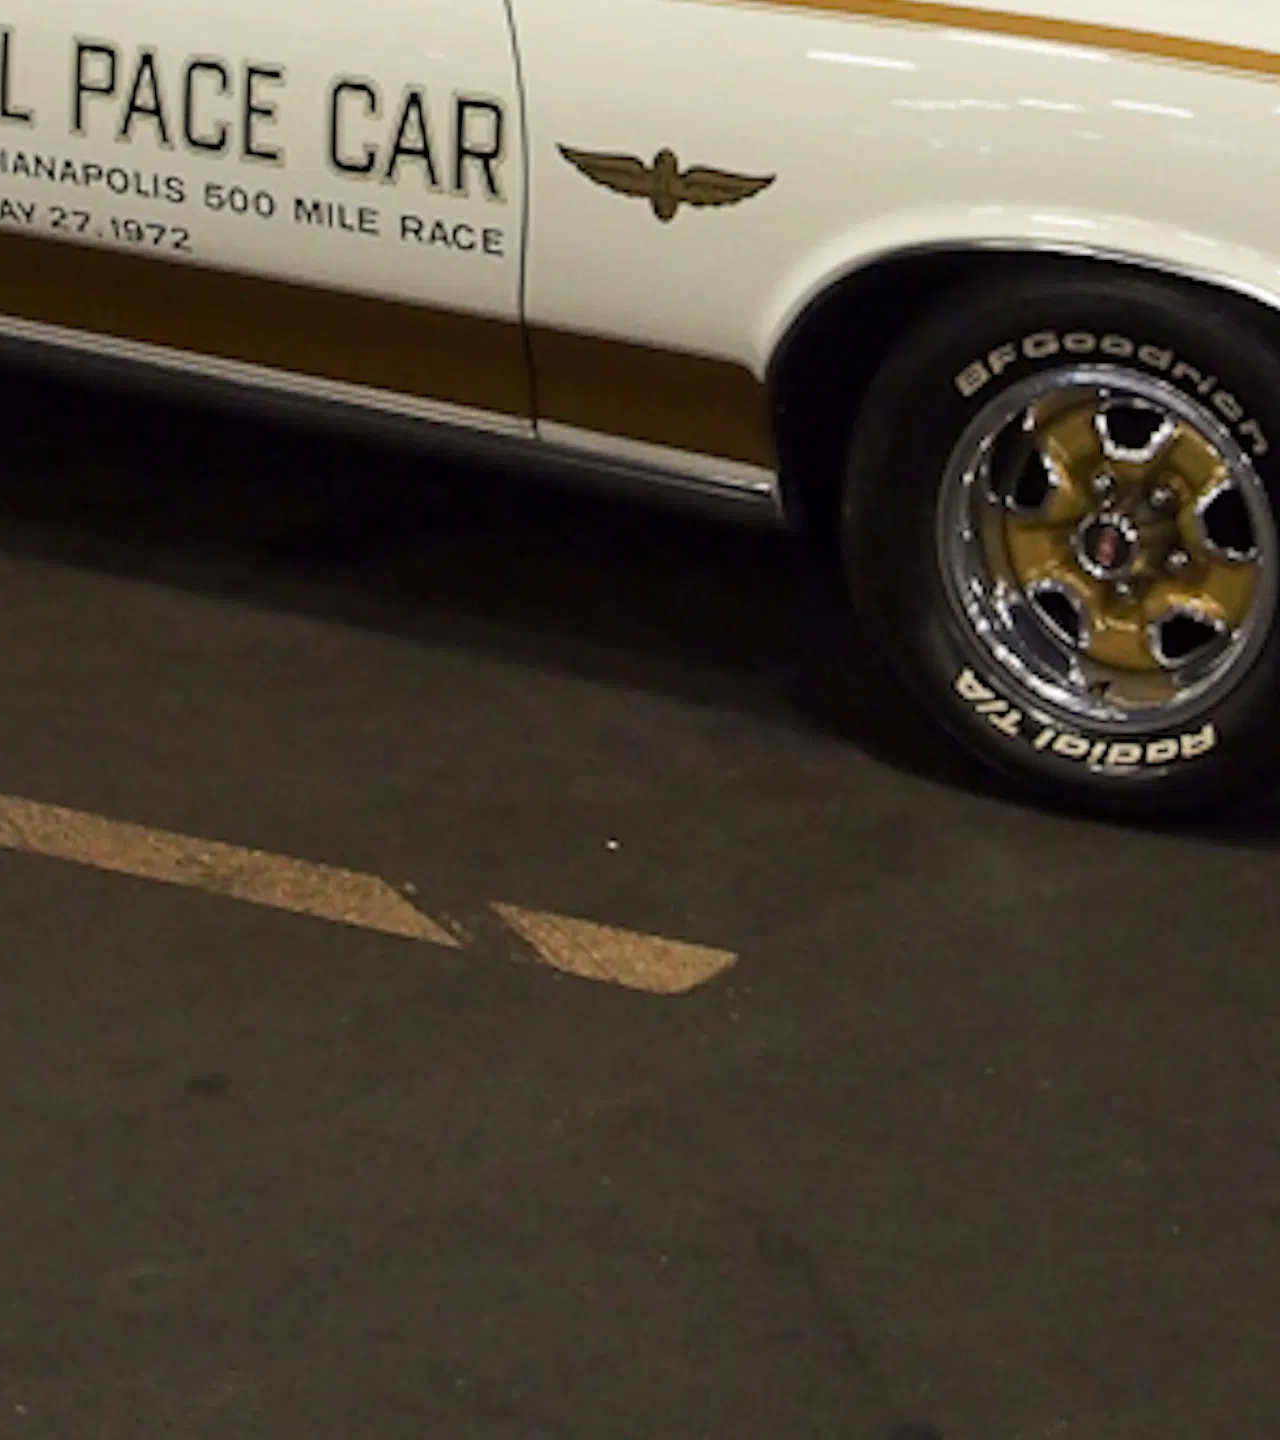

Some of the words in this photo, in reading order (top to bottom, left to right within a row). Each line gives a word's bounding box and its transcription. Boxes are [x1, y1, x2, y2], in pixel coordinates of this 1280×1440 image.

[70, 32, 286, 169] PACE
[328, 71, 508, 205] CAR
[203, 182, 276, 220] 500
[293, 198, 381, 237] MILE
[400, 214, 506, 257] RACE
[954, 330, 1269, 456] BFGoodrich
[954, 668, 1022, 738] T/A
